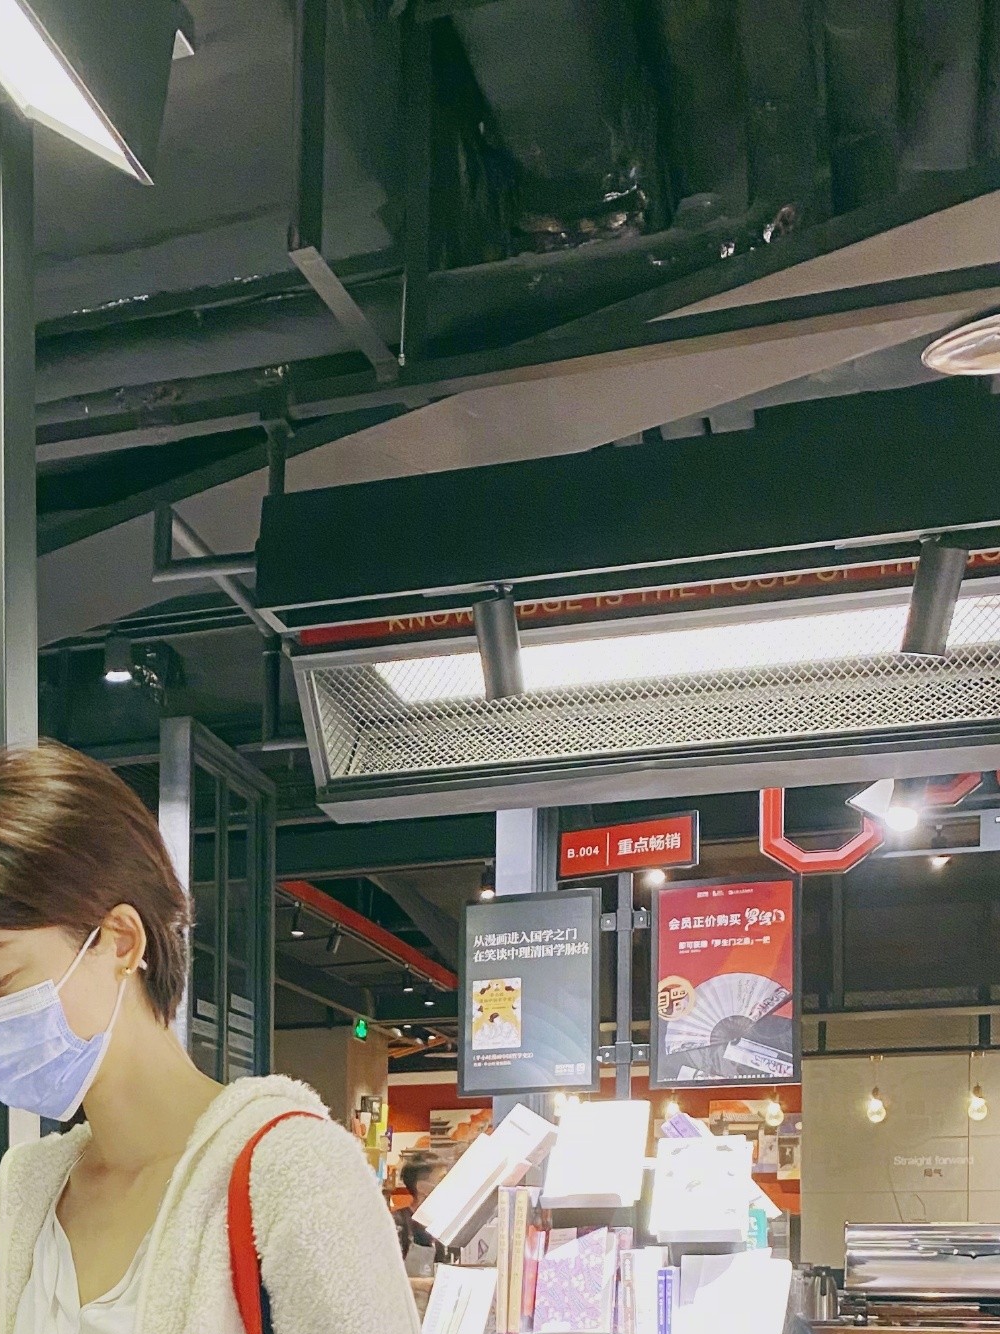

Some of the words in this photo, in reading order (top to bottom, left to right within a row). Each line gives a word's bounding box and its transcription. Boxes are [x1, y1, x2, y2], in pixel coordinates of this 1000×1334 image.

[567, 845, 599, 858] B.004
[617, 832, 681, 856] 重点畅销
[668, 913, 742, 931] 会员正价购买
[473, 927, 578, 949] 从漫画进入国学之门
[472, 941, 590, 964] 在笑谈中理清国学脉络
